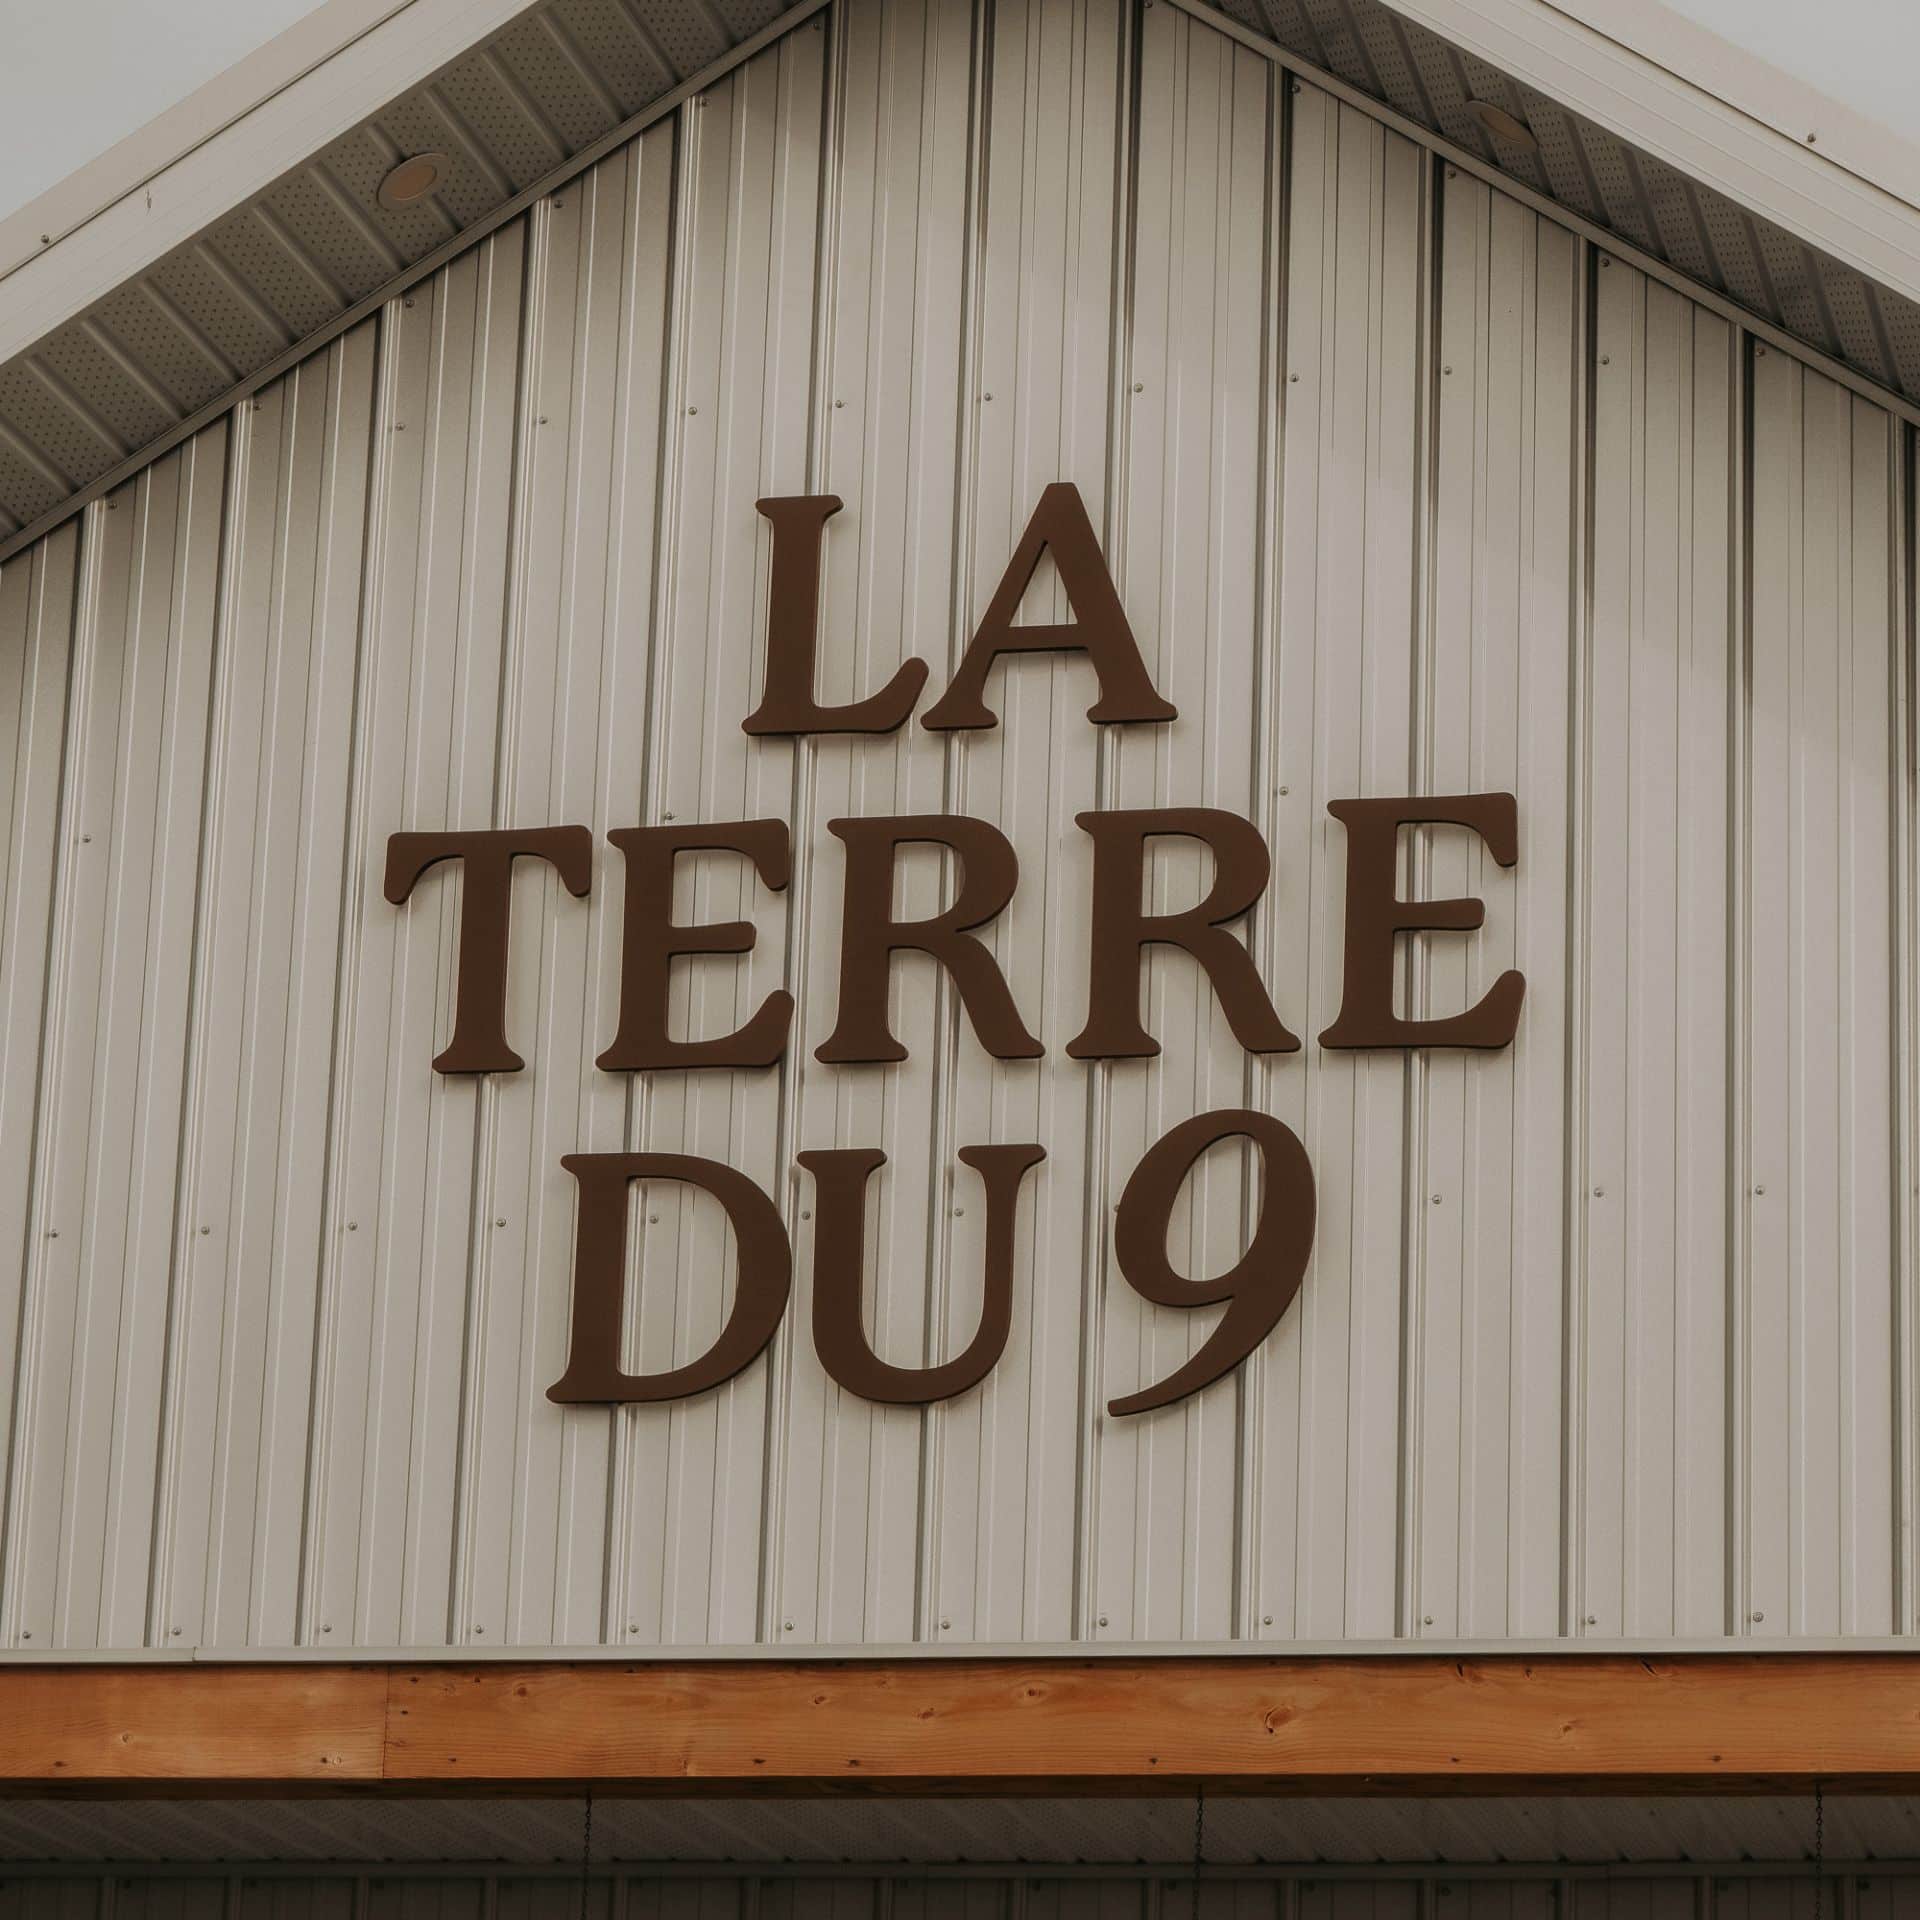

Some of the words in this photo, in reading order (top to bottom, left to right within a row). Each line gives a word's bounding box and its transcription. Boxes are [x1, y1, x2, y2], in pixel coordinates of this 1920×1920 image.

[743, 482, 1177, 736] LA
[385, 792, 1526, 1076] TERRE
[546, 1144, 1046, 1407] DU
[1108, 1110, 1316, 1418] 9
